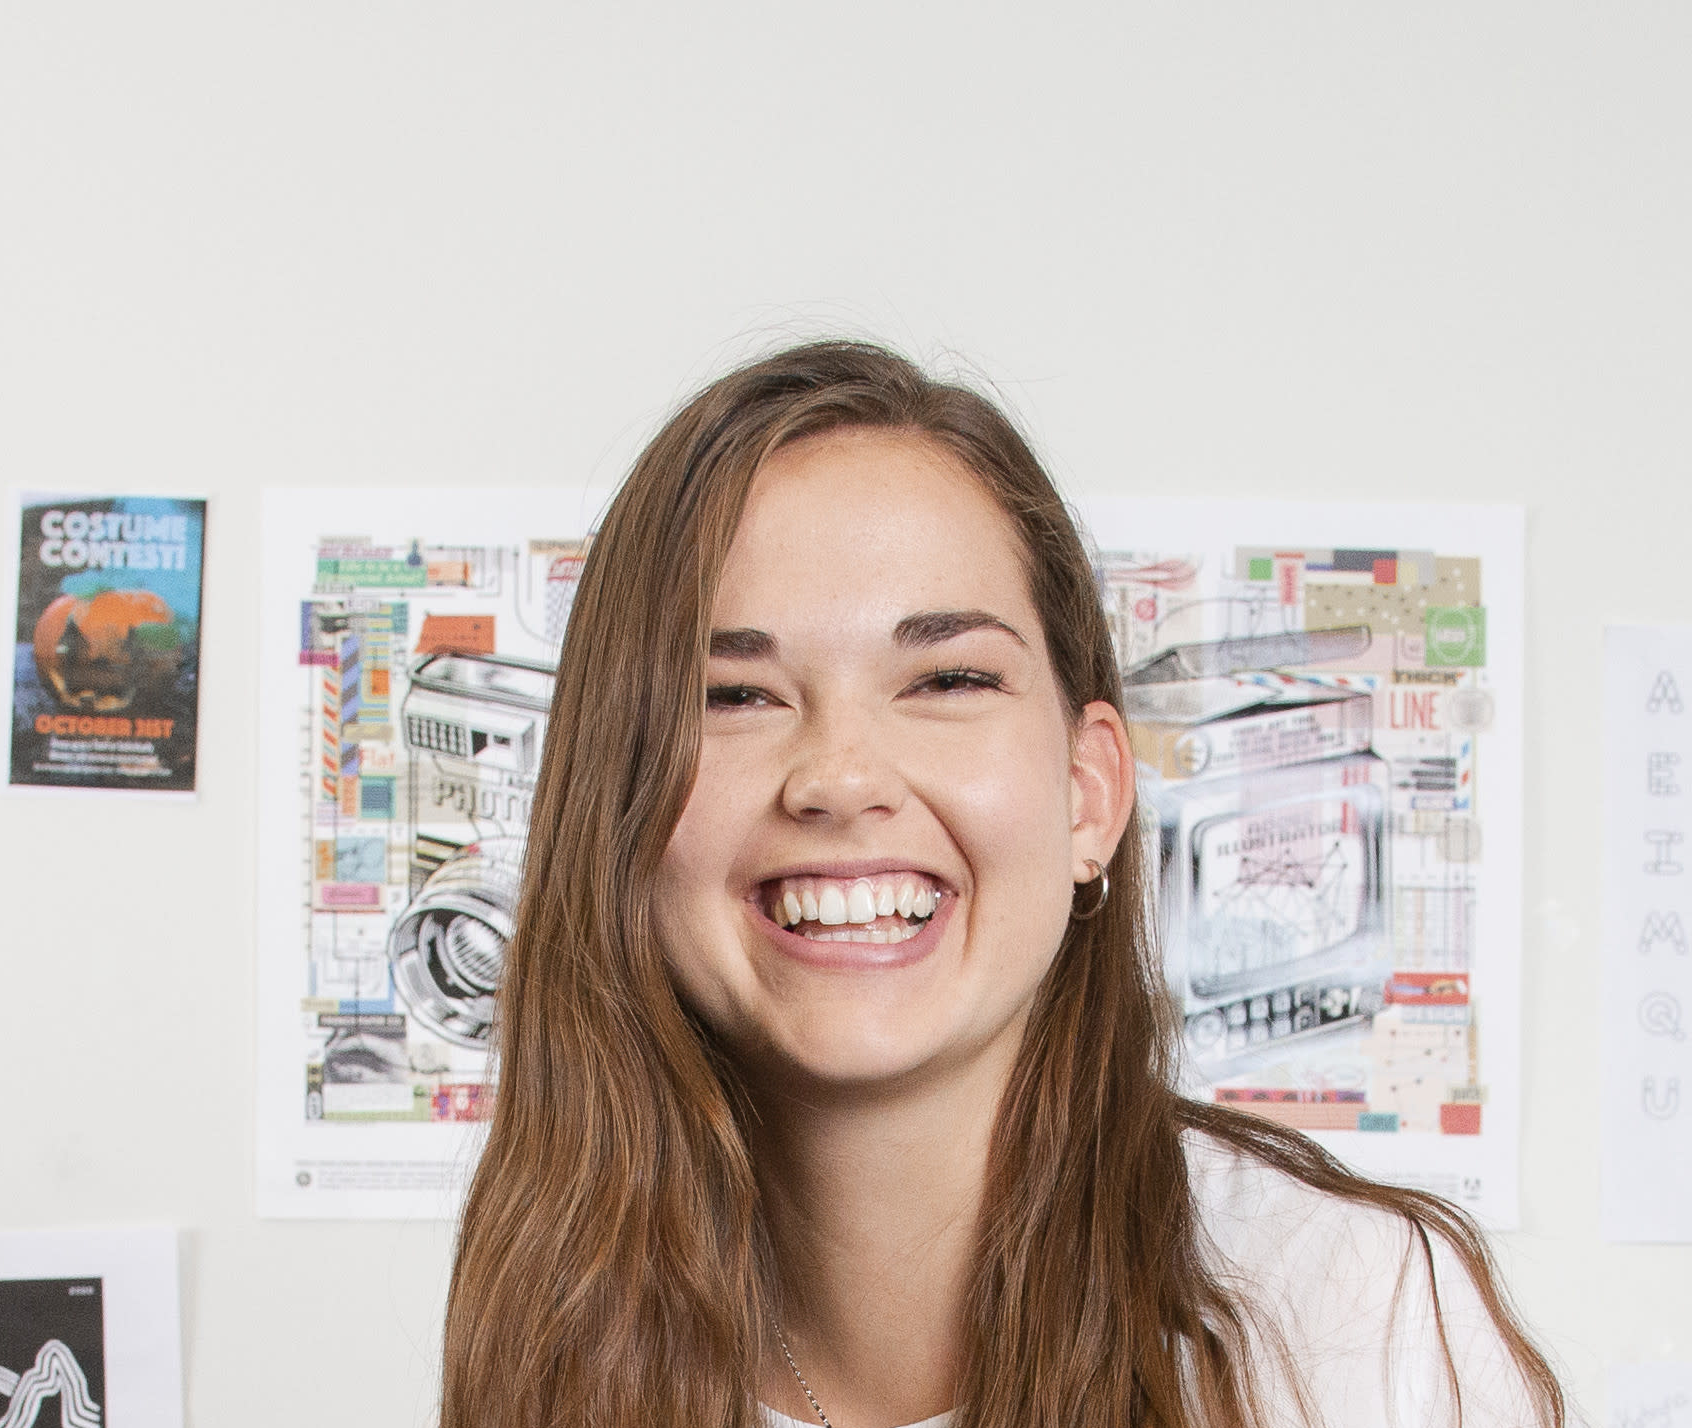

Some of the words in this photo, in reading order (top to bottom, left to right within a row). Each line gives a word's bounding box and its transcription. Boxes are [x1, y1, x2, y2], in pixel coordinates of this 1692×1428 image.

[40, 510, 187, 542] COSTUME
[39, 538, 185, 569] CONTEST!
[35, 714, 133, 736] OCTOBER
[1390, 691, 1440, 730] LINE
